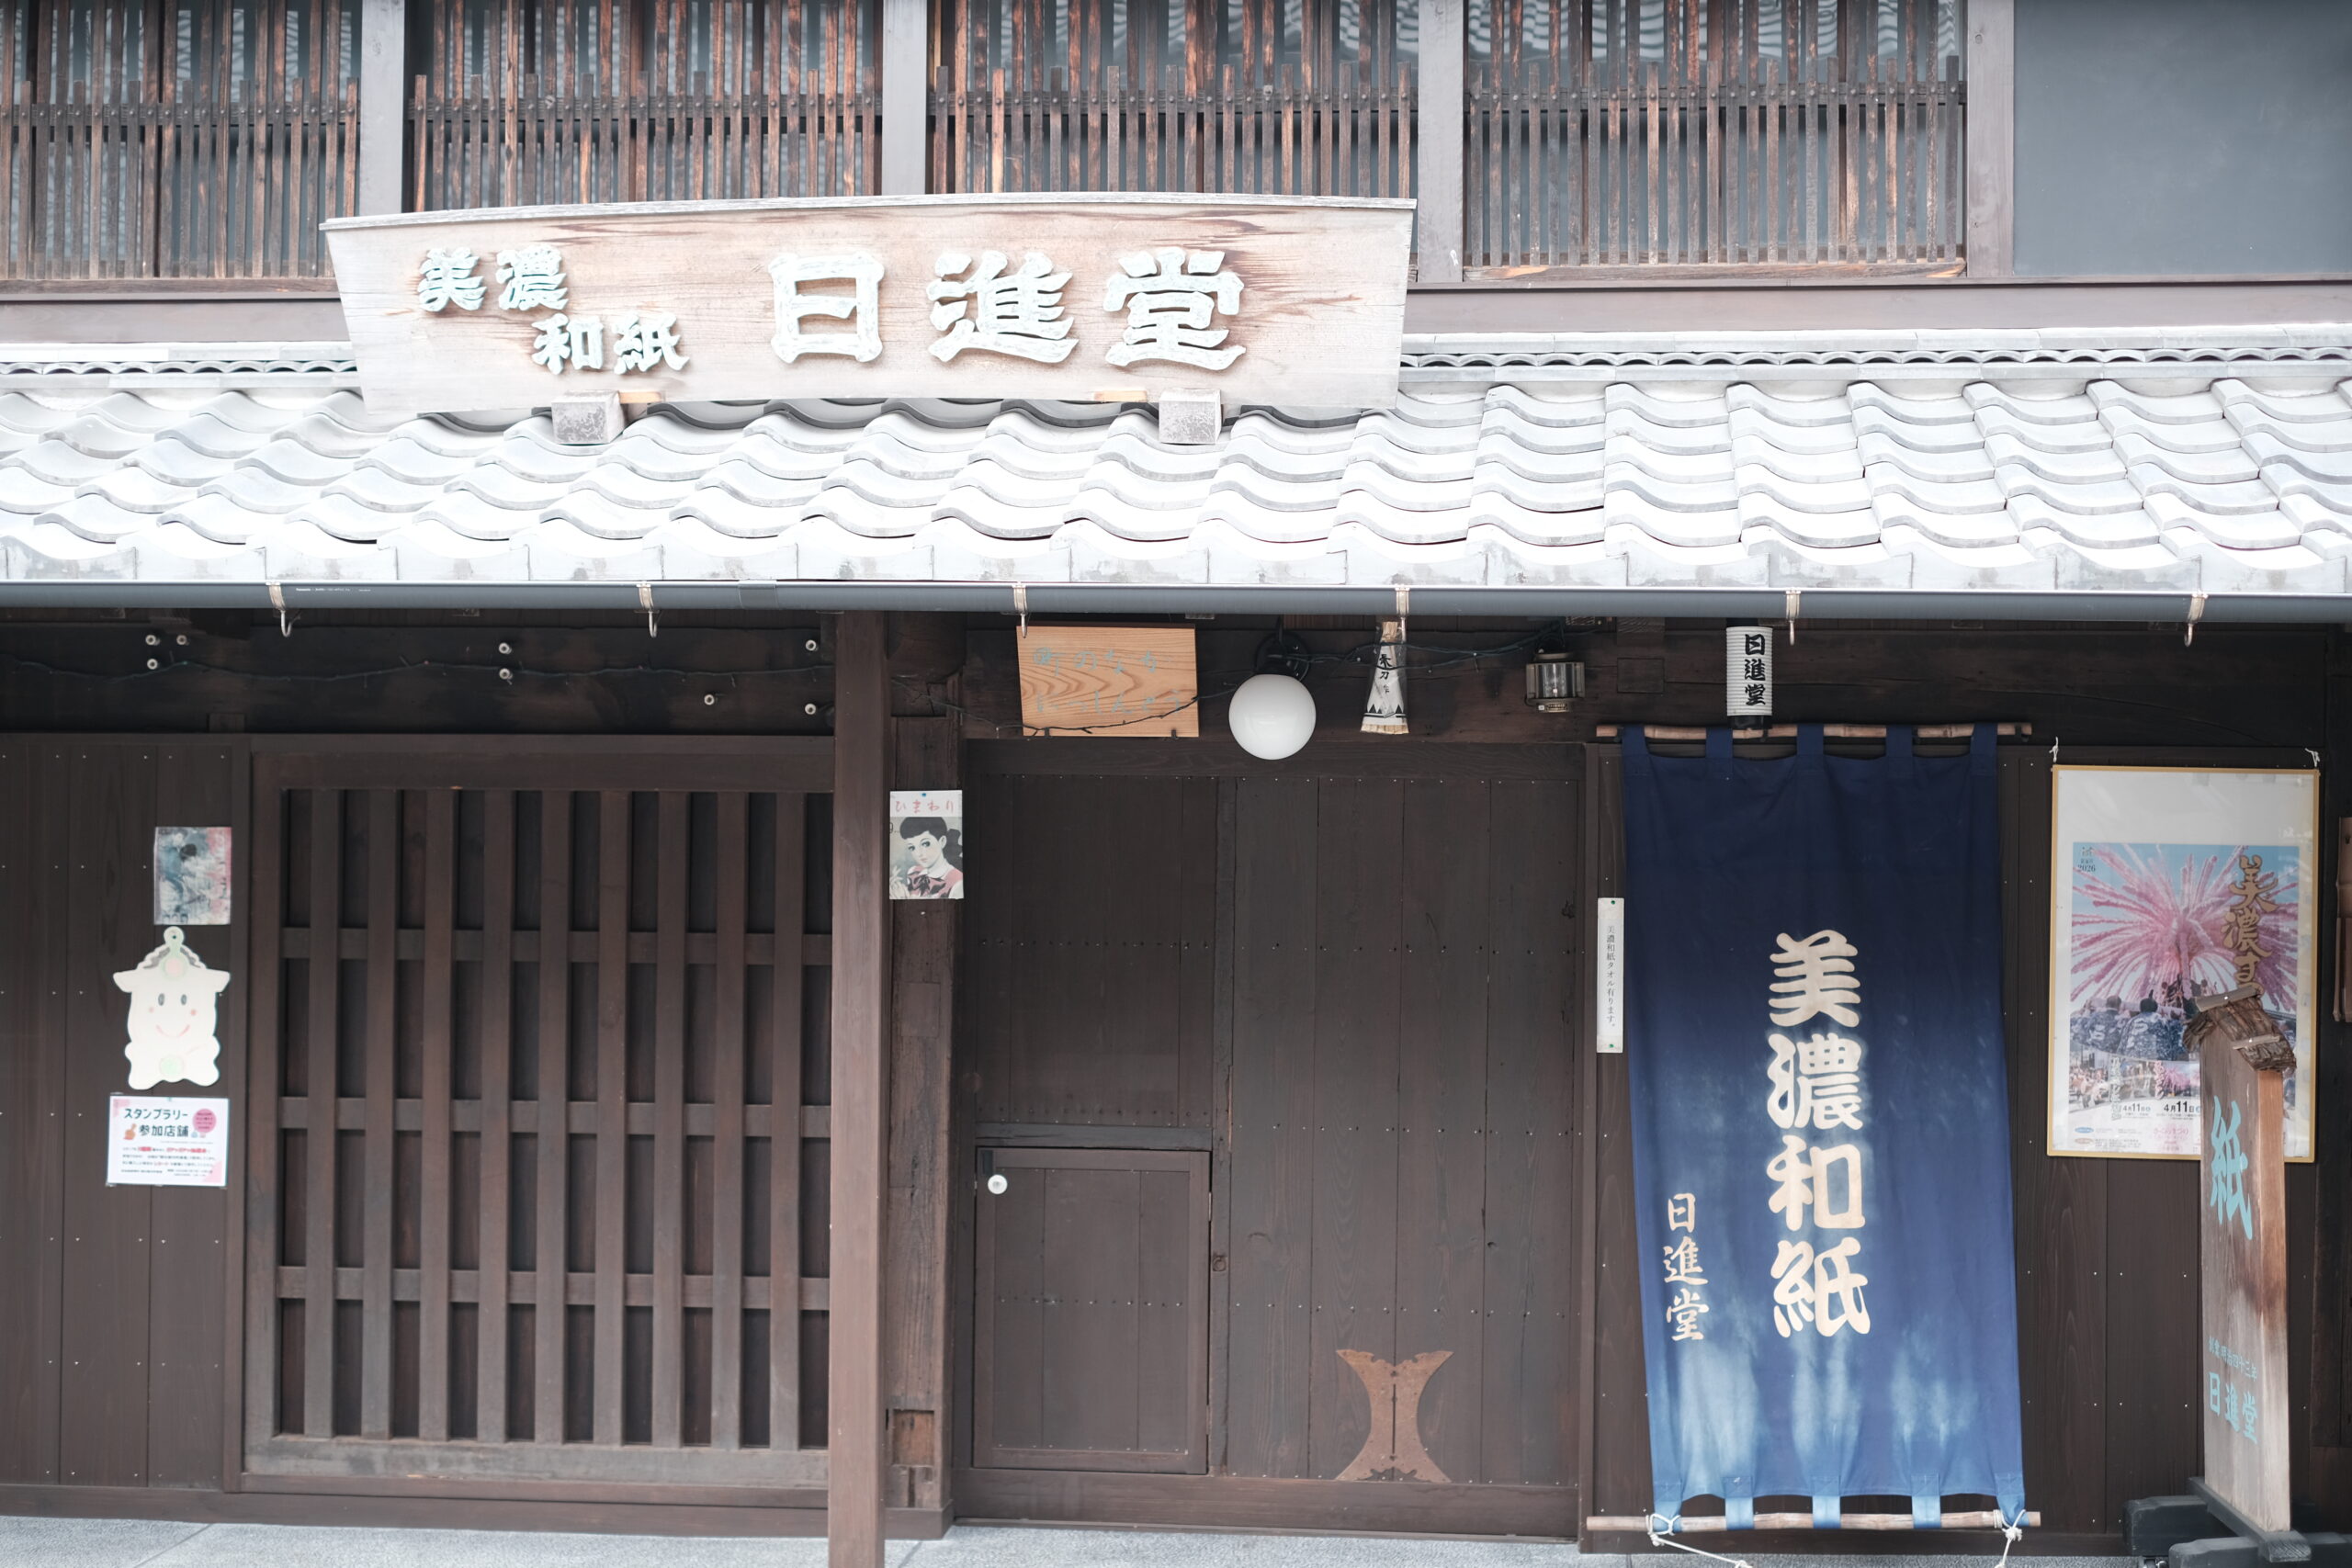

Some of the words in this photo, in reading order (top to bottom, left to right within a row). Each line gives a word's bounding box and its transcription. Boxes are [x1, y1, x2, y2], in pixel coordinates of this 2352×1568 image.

[417, 246, 569, 312] 美濃
[768, 246, 1247, 371] 日進堂
[531, 312, 690, 376] 和紙
[1744, 634, 1766, 706] 日進堂
[895, 799, 955, 814] ひまわり
[124, 1108, 188, 1120] スタンプラリー
[140, 1125, 189, 1137] 参加店舗
[1767, 930, 1871, 1338] 美濃和紙
[2210, 1095, 2253, 1240] 紙
[1663, 1193, 1711, 1342] 日進堂
[2209, 1371, 2257, 1445] 日進堂
